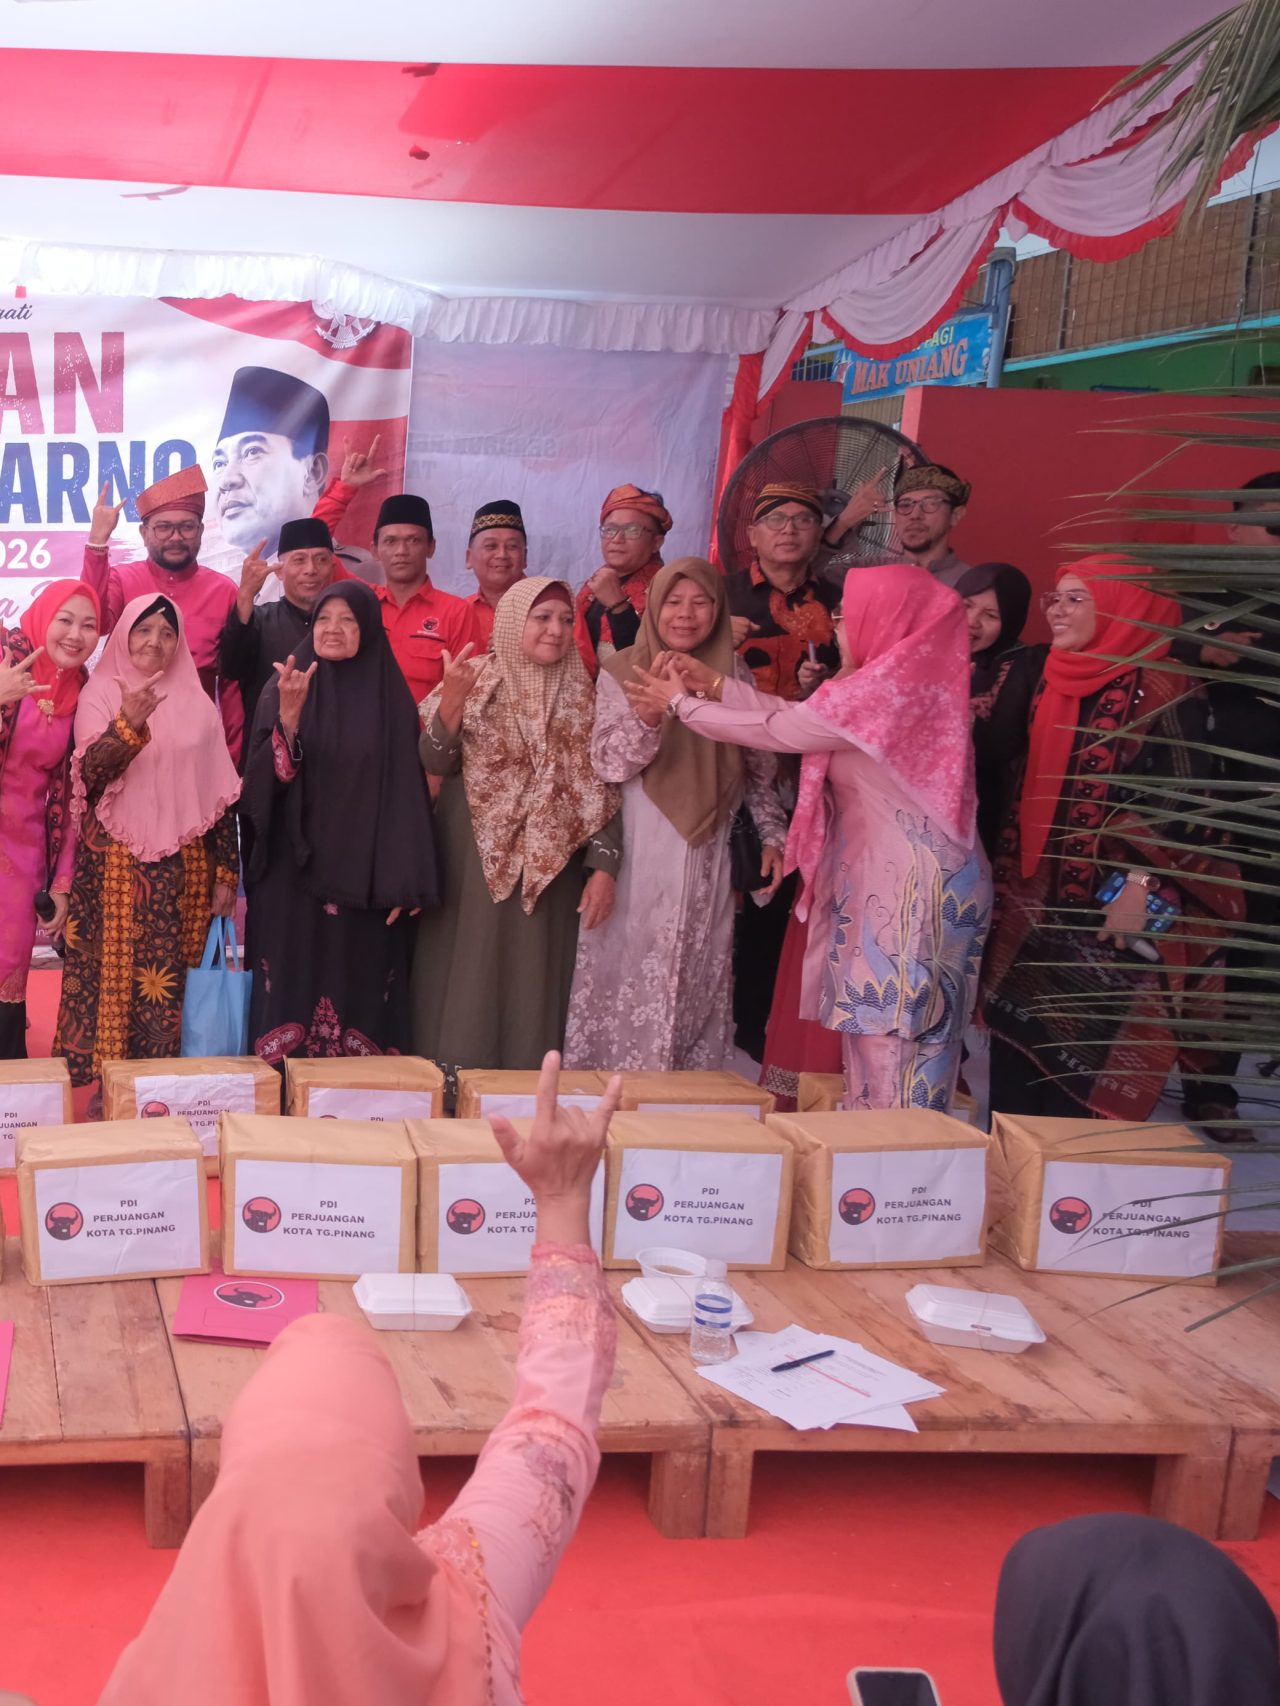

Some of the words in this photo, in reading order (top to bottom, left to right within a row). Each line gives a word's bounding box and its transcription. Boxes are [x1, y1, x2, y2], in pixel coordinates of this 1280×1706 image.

[851, 360, 891, 395] MAK
[701, 1187, 720, 1195] PDI
[911, 1186, 927, 1194] PDI
[120, 1199, 138, 1208] PDI
[319, 1200, 338, 1209] PDI
[673, 1200, 745, 1210] PERJUANGAN
[884, 1199, 952, 1209] PERJUANGAN
[93, 1211, 165, 1222] PERJUANGAN
[291, 1212, 365, 1224] PERJUANGAN
[495, 1211, 538, 1219] PERJUA
[663, 1214, 694, 1224] KOTA
[697, 1216, 753, 1226] TG.PINANG
[906, 1214, 961, 1222] TG.PINANG
[1102, 1212, 1181, 1223] PERJUANGAN
[86, 1229, 116, 1238] KOTA
[119, 1224, 176, 1236] TG.PINANG
[283, 1227, 313, 1236] KOTA
[316, 1228, 375, 1239] TG.PINANG
[487, 1226, 517, 1234] KOTA
